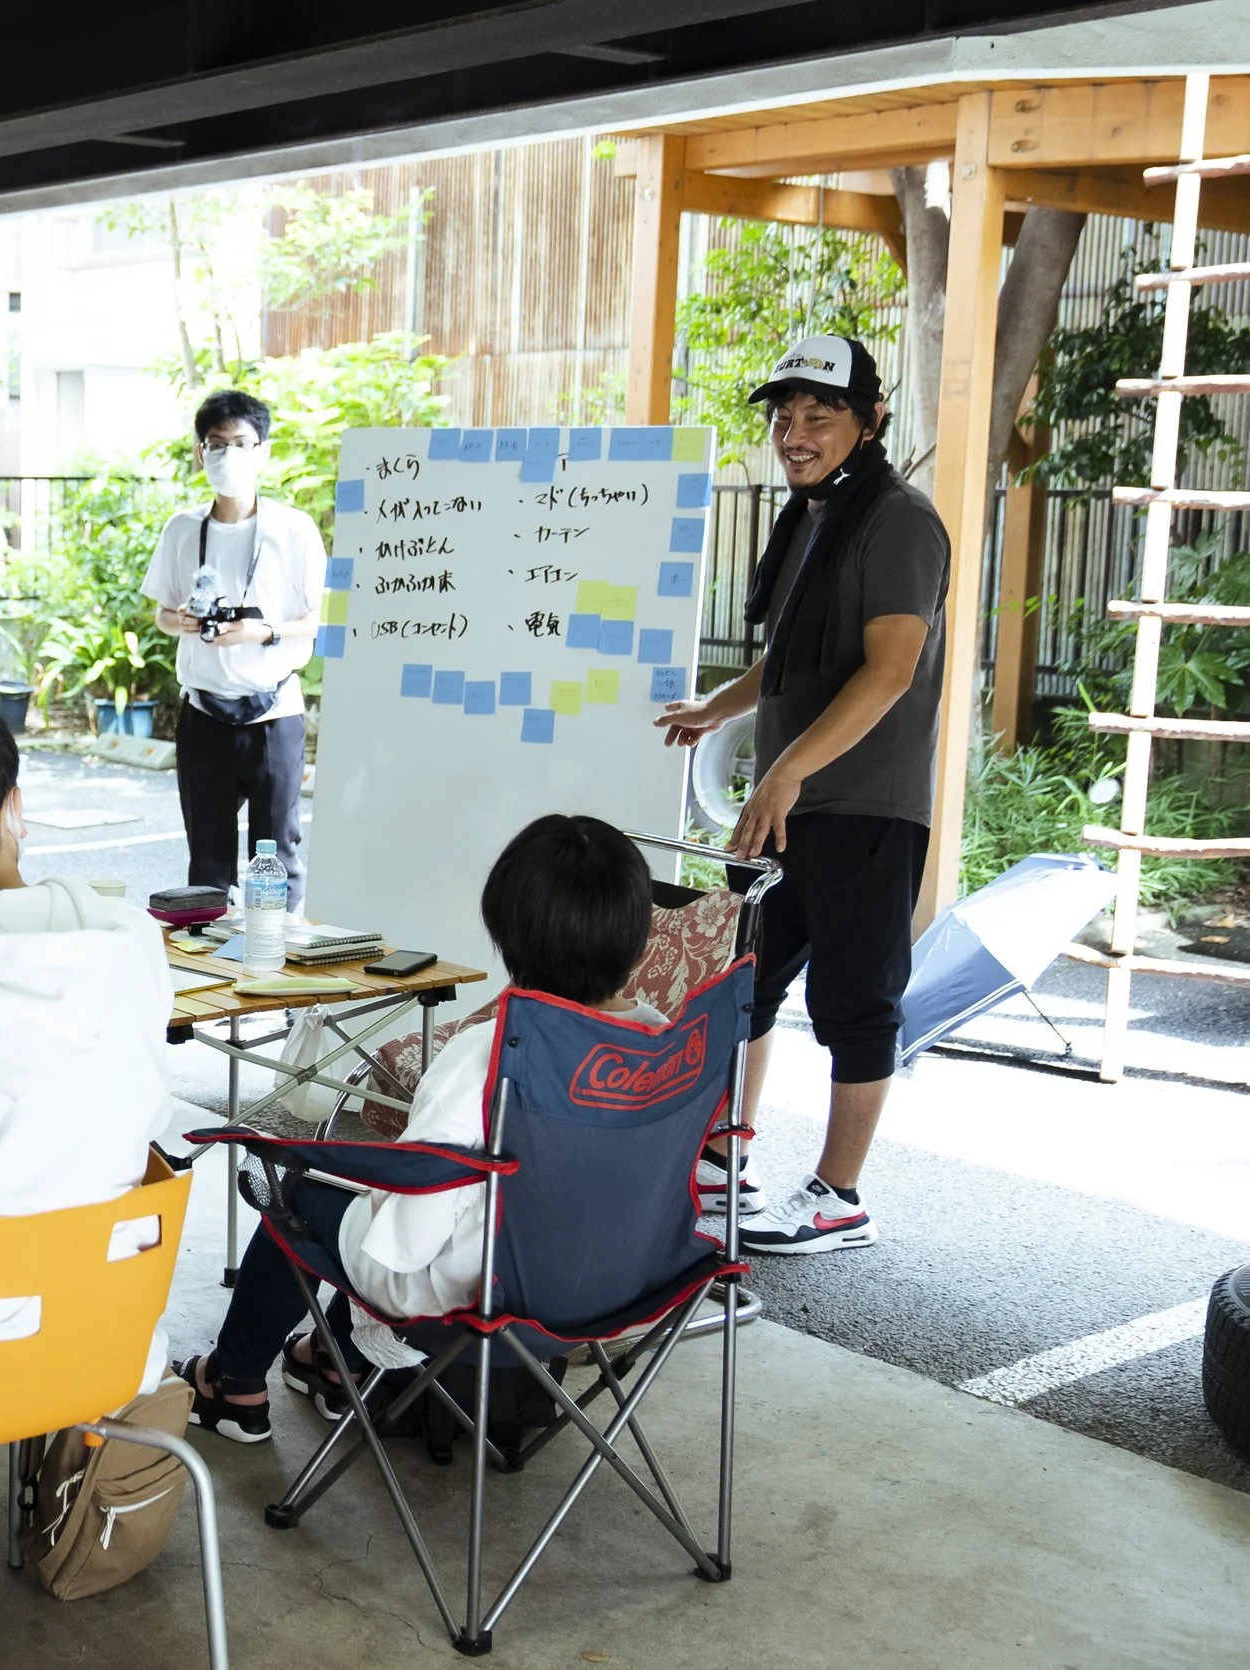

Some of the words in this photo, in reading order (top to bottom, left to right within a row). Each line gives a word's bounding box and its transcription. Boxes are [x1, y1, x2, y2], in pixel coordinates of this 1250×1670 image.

[376, 454, 420, 480] まくら
[534, 526, 590, 543] カーテン
[525, 565, 579, 583] エアコン
[525, 611, 561, 637] 電気
